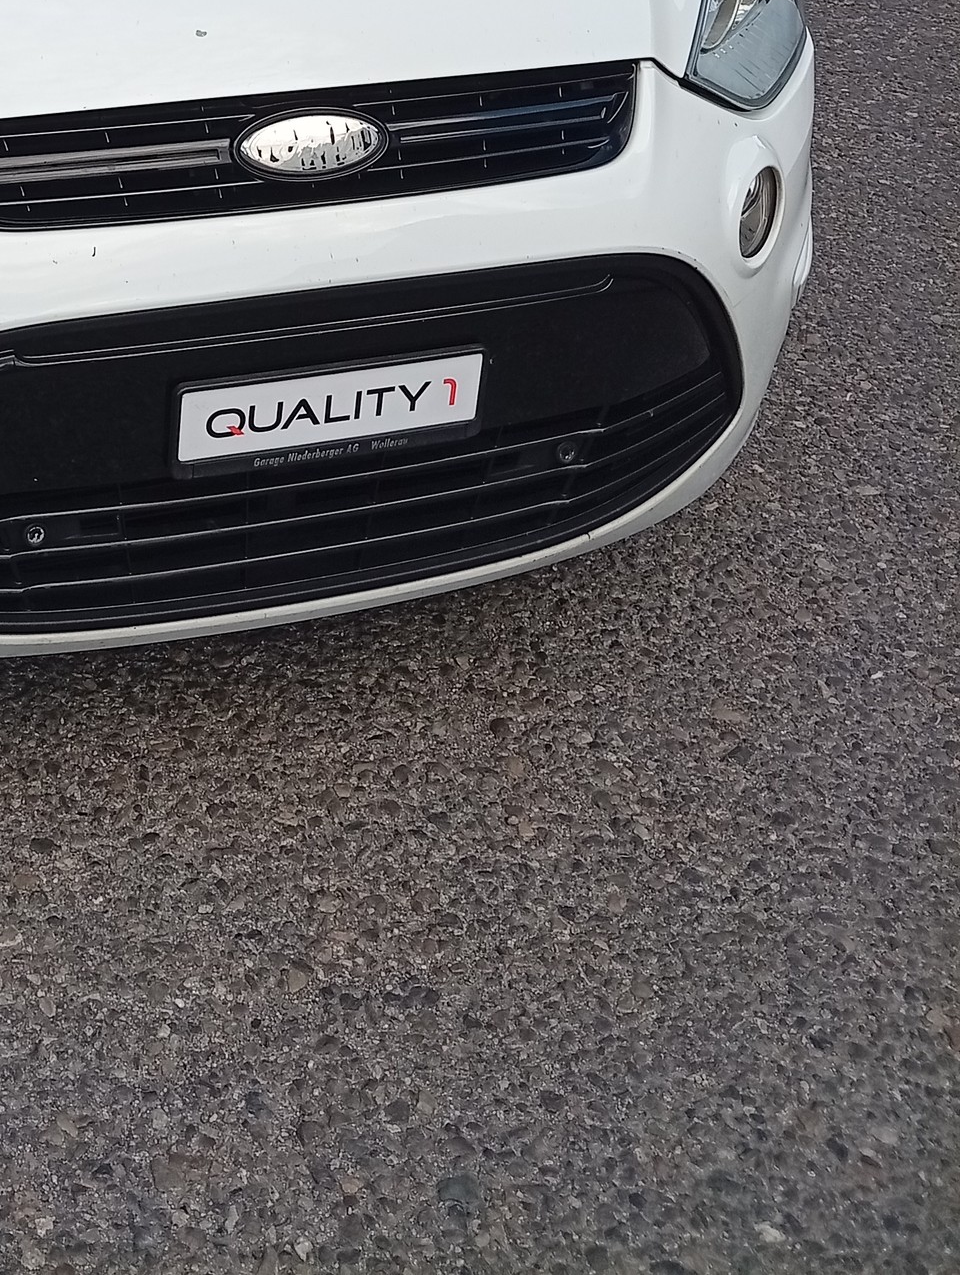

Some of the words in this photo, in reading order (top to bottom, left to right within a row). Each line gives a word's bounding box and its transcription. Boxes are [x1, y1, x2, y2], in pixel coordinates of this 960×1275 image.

[205, 380, 432, 439] QUALITY
[443, 378, 457, 406] 1
[253, 456, 285, 467] Garage
[287, 447, 344, 463] Niederberger
[346, 443, 360, 454] AG
